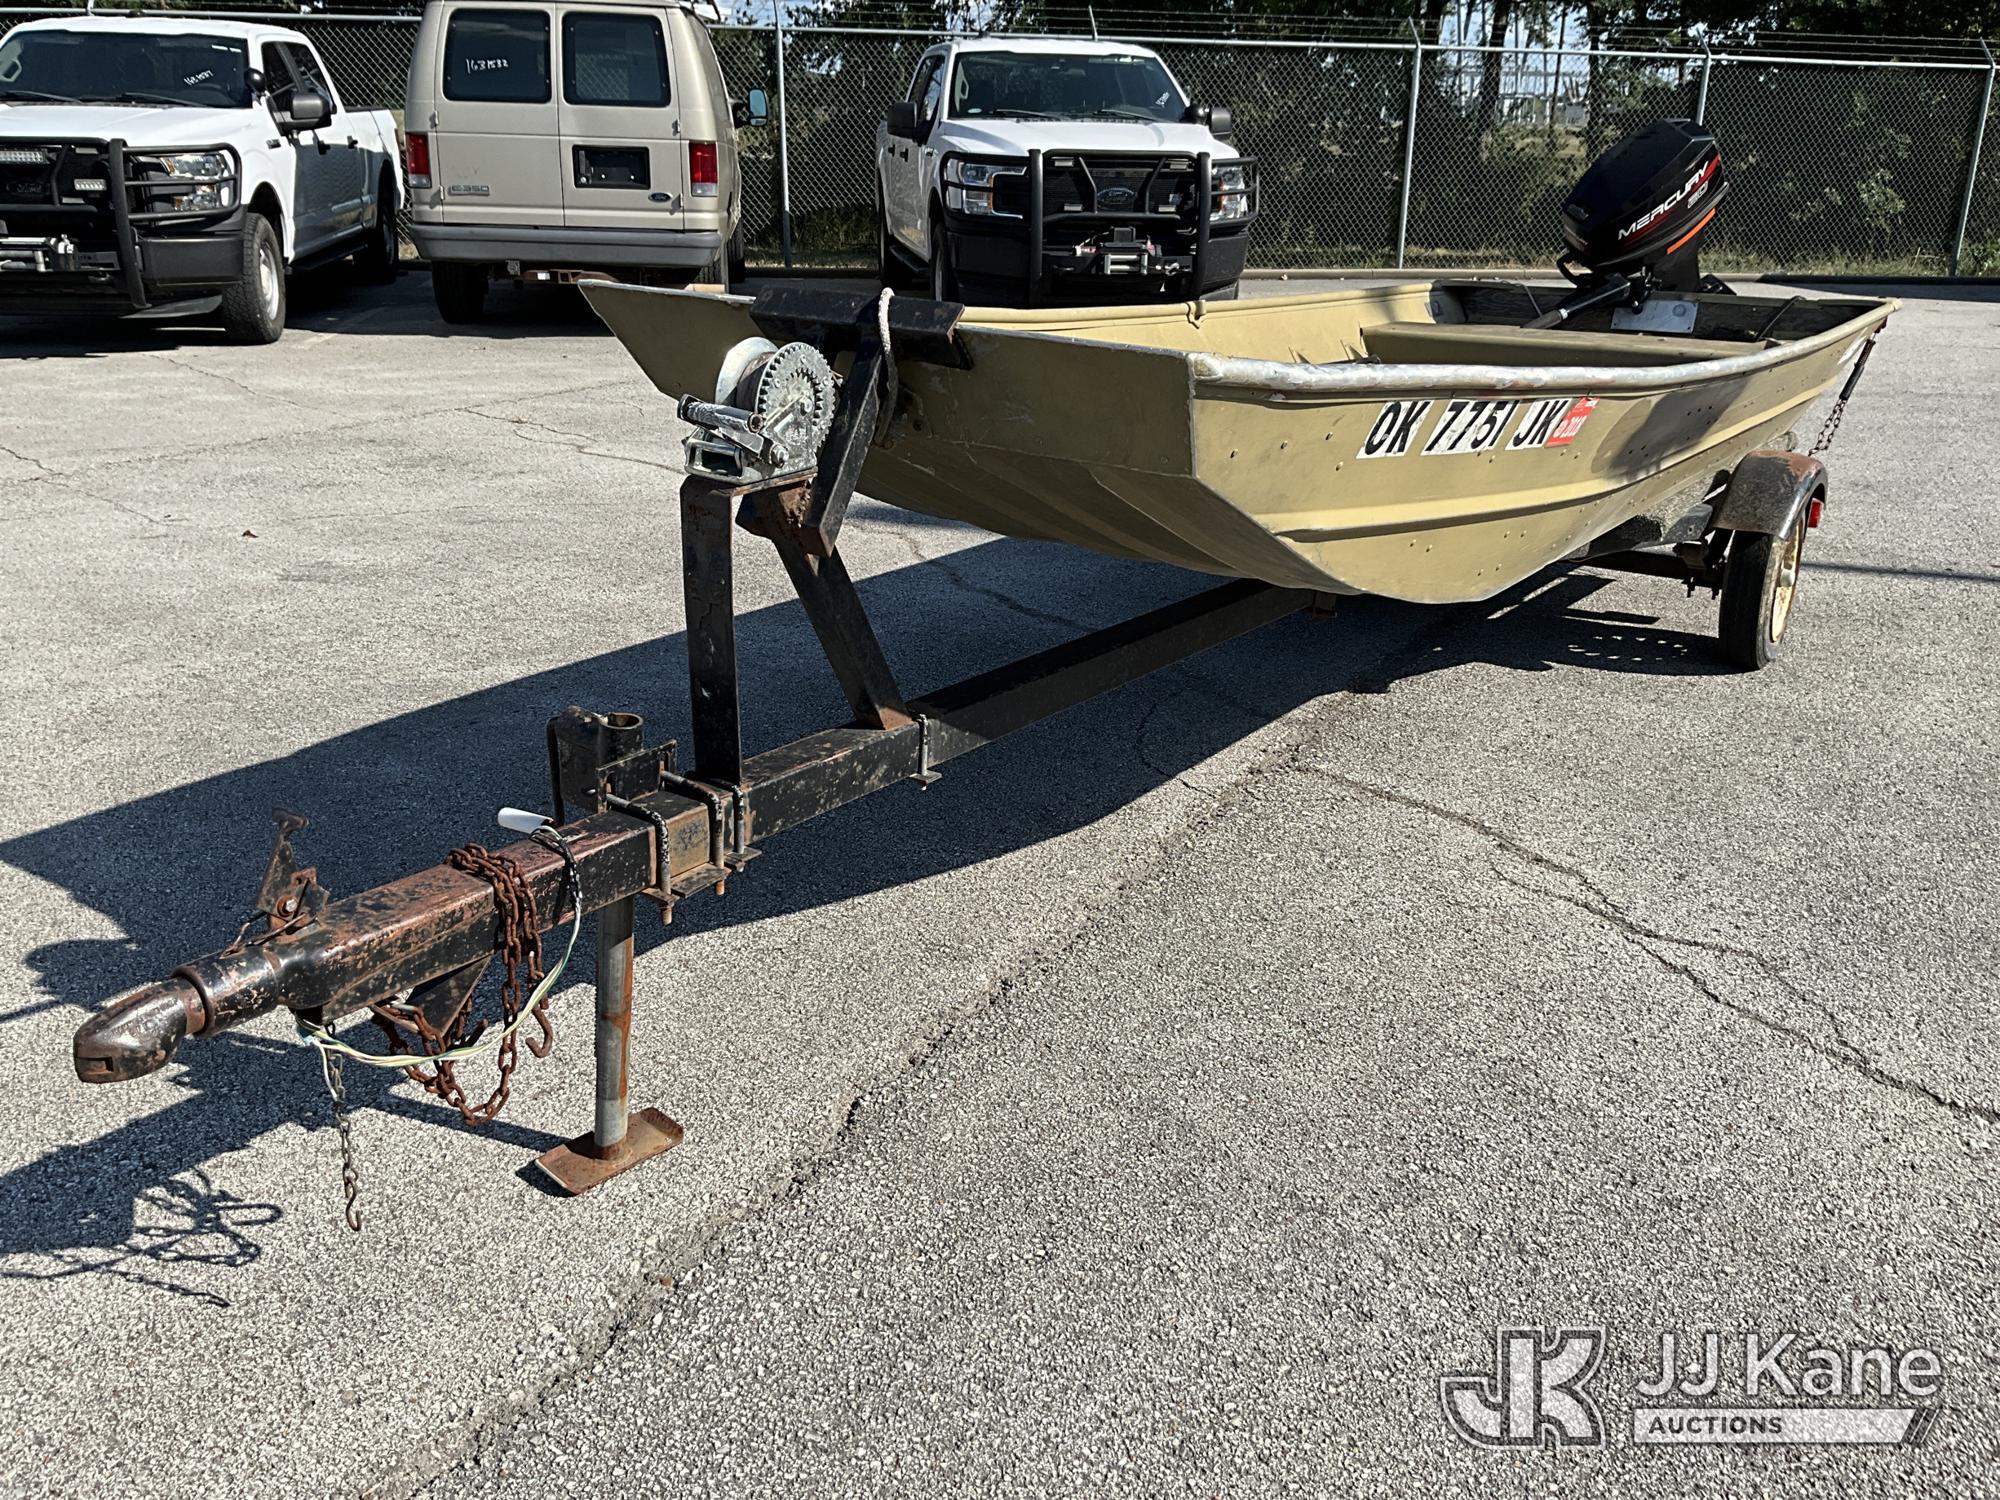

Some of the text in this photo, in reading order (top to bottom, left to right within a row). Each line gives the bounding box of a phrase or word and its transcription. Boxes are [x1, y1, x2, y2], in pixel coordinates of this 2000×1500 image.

[1618, 161, 1709, 240] MERCURY
[1365, 400, 1431, 455] OK
[1425, 400, 1521, 451] 7751
[1512, 400, 1568, 447] JK
